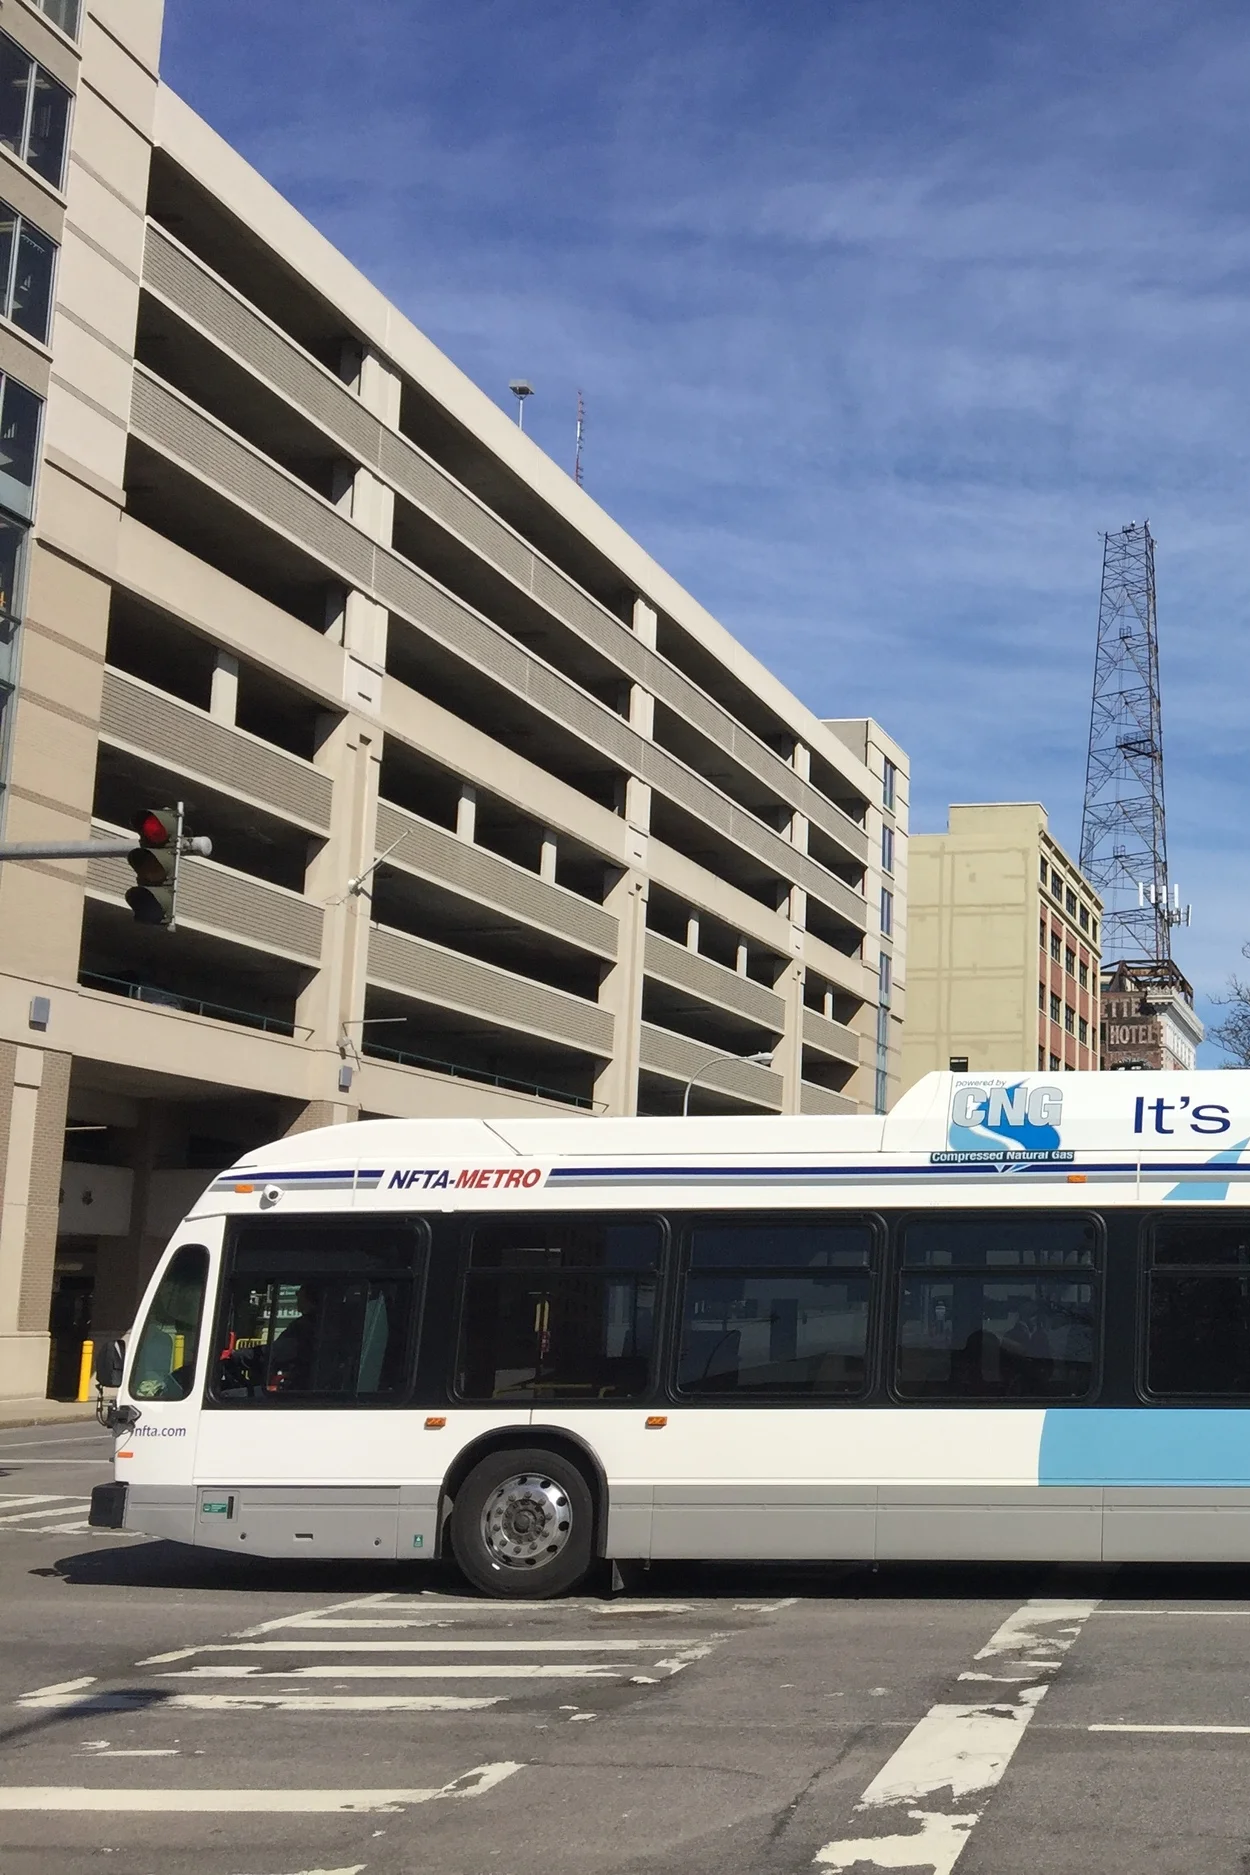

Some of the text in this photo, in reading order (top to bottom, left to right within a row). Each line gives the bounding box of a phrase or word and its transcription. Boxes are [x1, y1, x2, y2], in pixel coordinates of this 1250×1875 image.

[1110, 1025, 1156, 1045] HOTEL
[955, 1079, 1007, 1087] powered by
[952, 1086, 1064, 1128] CNG
[1134, 1096, 1231, 1134] It's
[932, 1151, 1074, 1163] Compressed Natural Gas
[387, 1168, 542, 1189] NFTA-METRO
[135, 1425, 186, 1437] nfta.com
